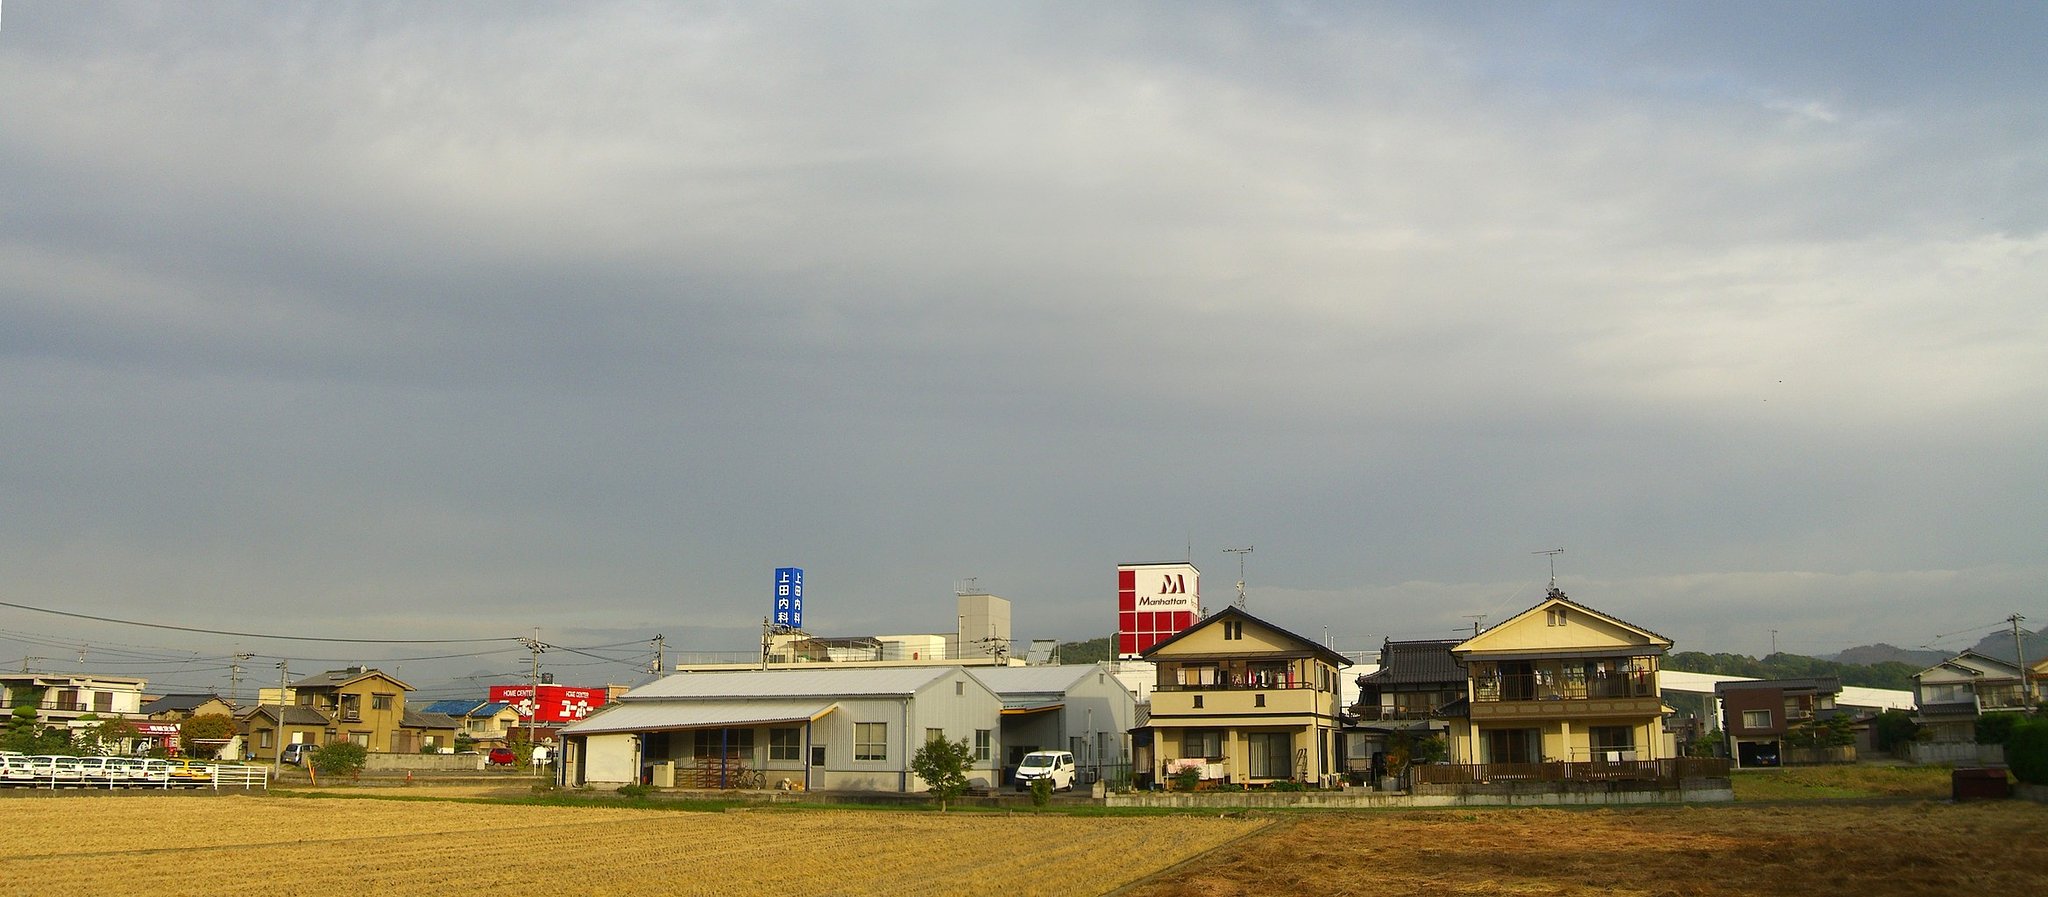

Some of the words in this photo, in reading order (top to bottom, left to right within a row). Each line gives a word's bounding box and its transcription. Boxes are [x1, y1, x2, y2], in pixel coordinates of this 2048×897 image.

[778, 571, 790, 624] 上田内科
[1138, 596, 1187, 606] Manhattan
[559, 700, 594, 718] ユーホー
